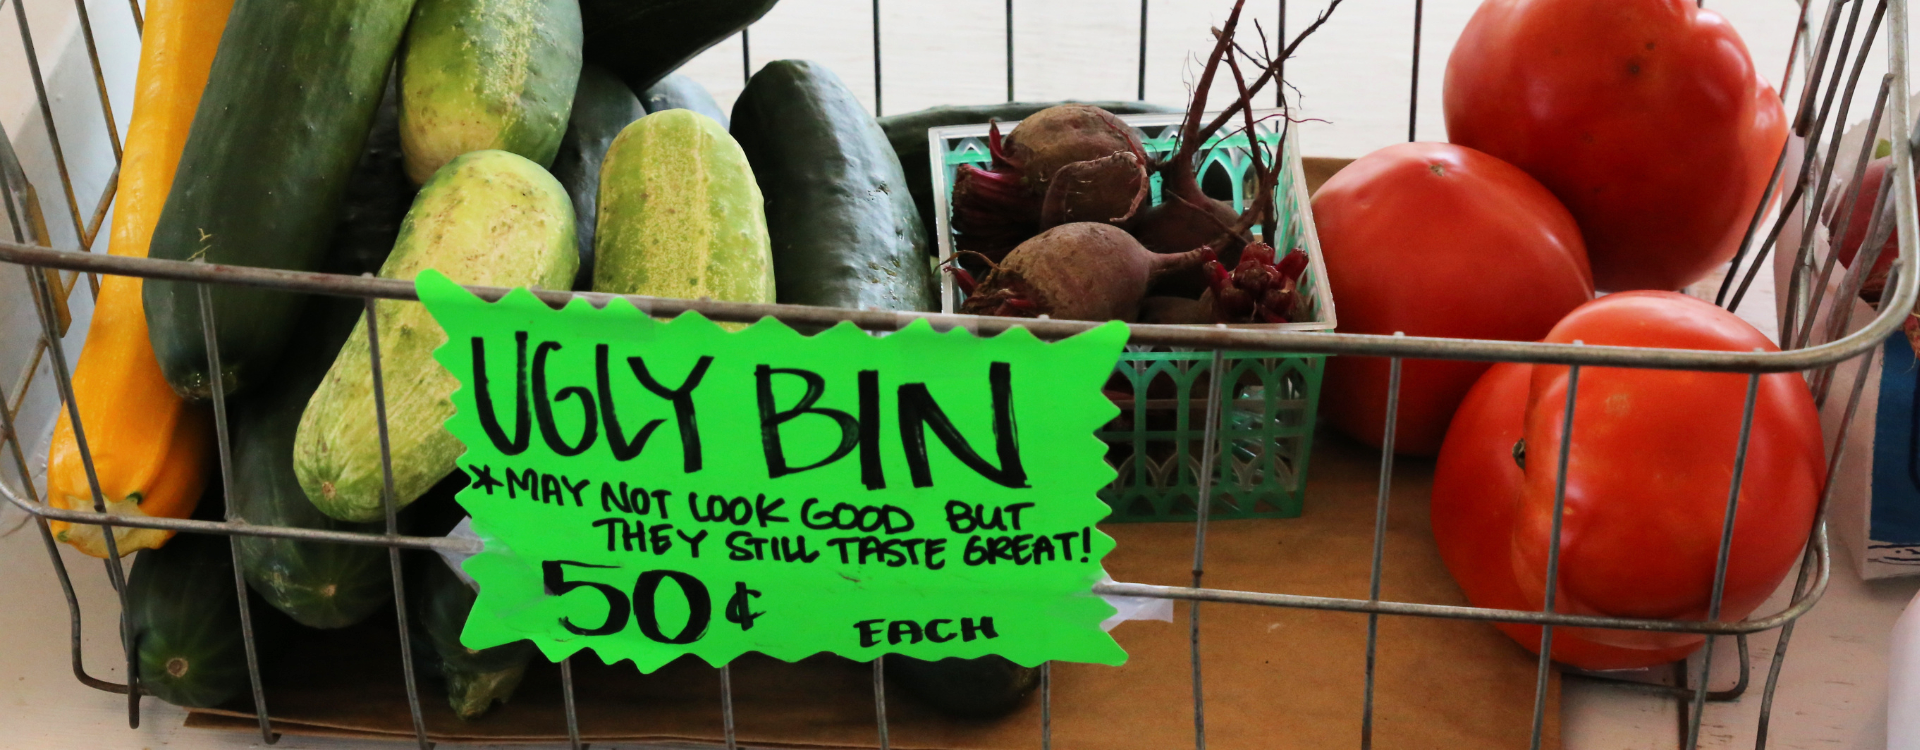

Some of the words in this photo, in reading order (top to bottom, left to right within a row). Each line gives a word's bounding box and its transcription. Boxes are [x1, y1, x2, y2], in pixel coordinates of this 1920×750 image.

[471, 331, 714, 473] UGLY
[754, 362, 1032, 489] BIN
[601, 482, 671, 519] NOT
[689, 492, 789, 527] LOOK
[801, 498, 914, 534] GOOD
[945, 500, 1035, 534] BUT
[592, 518, 708, 558] THEY
[725, 529, 821, 563] STILL
[827, 535, 947, 570] TASTE
[963, 531, 1092, 566] GREAT!
[853, 615, 999, 648] EACH
